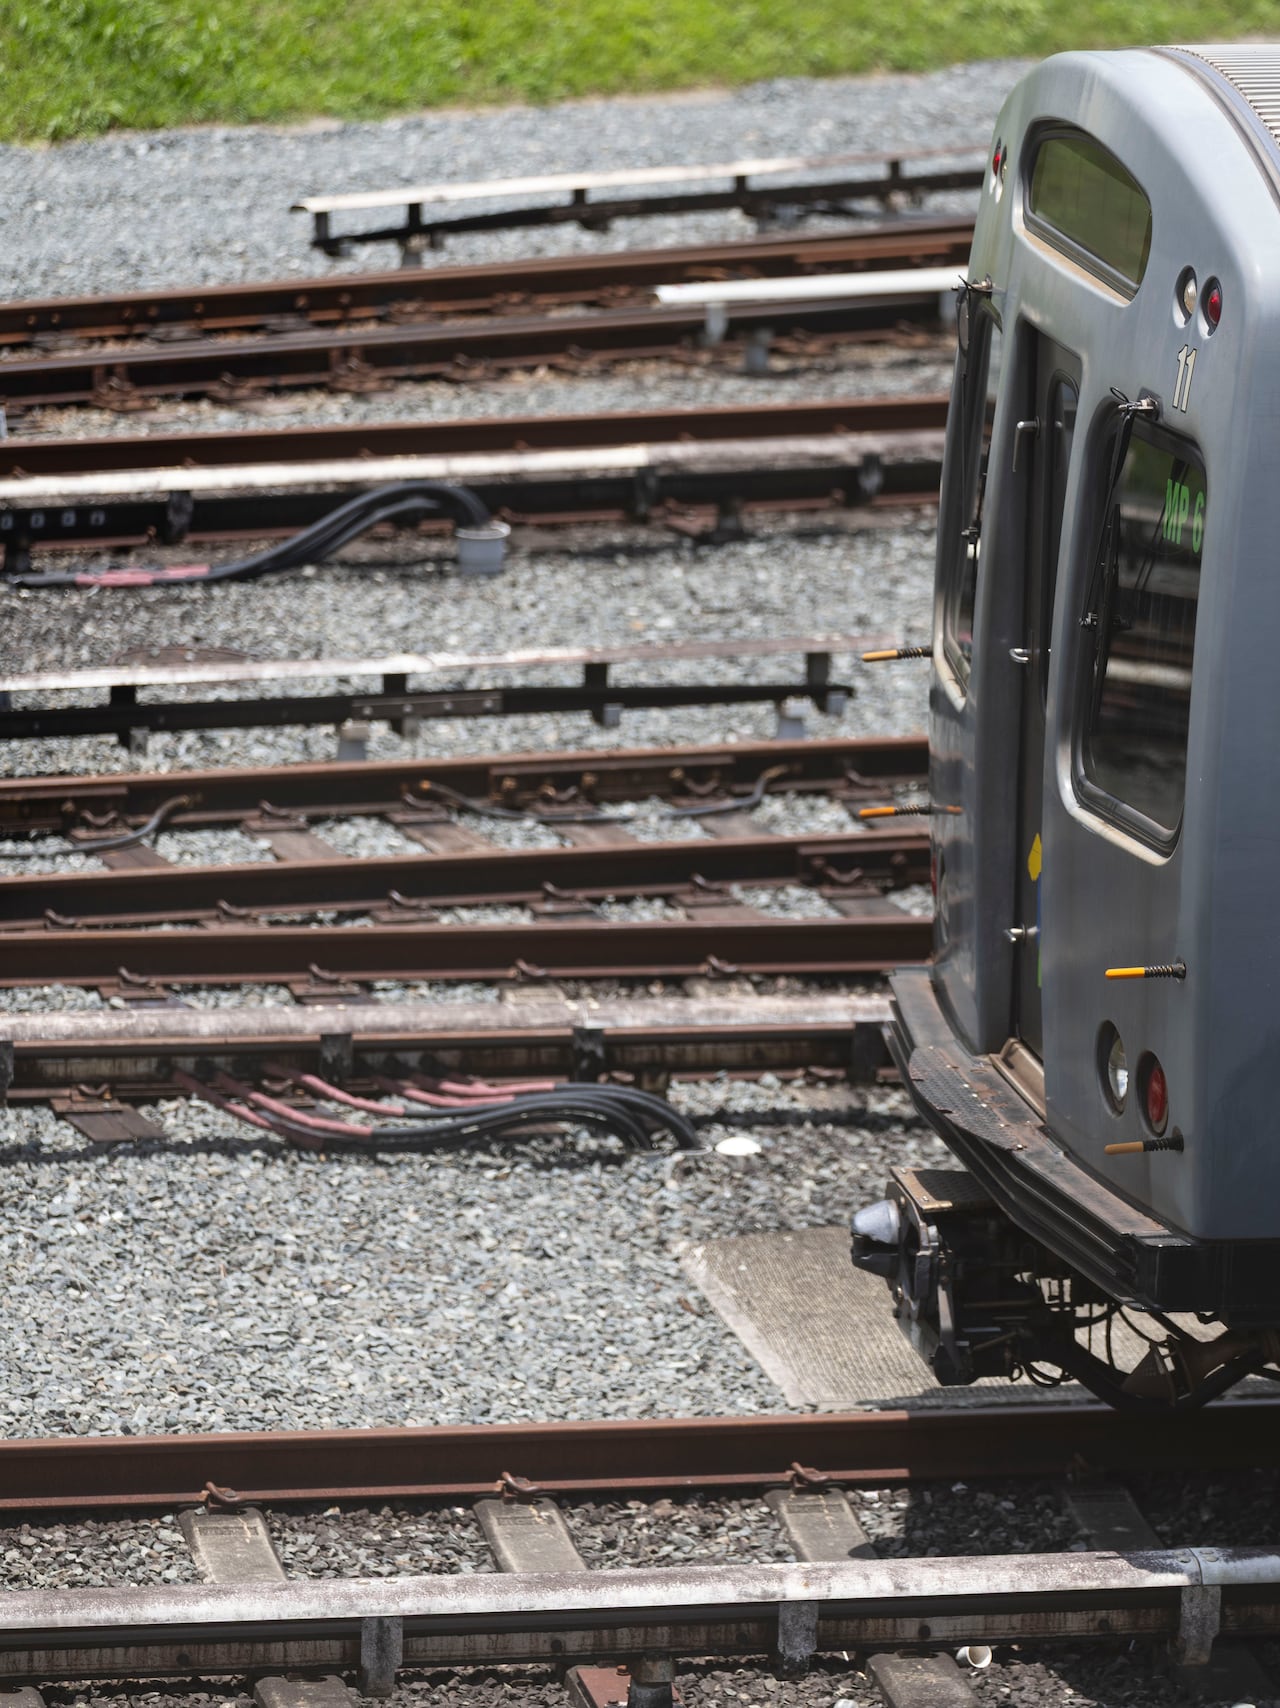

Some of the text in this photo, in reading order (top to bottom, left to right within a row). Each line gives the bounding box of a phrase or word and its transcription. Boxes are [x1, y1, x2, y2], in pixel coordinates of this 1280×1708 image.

[1173, 343, 1197, 412] 11
[1164, 479, 1205, 554] MP 6
